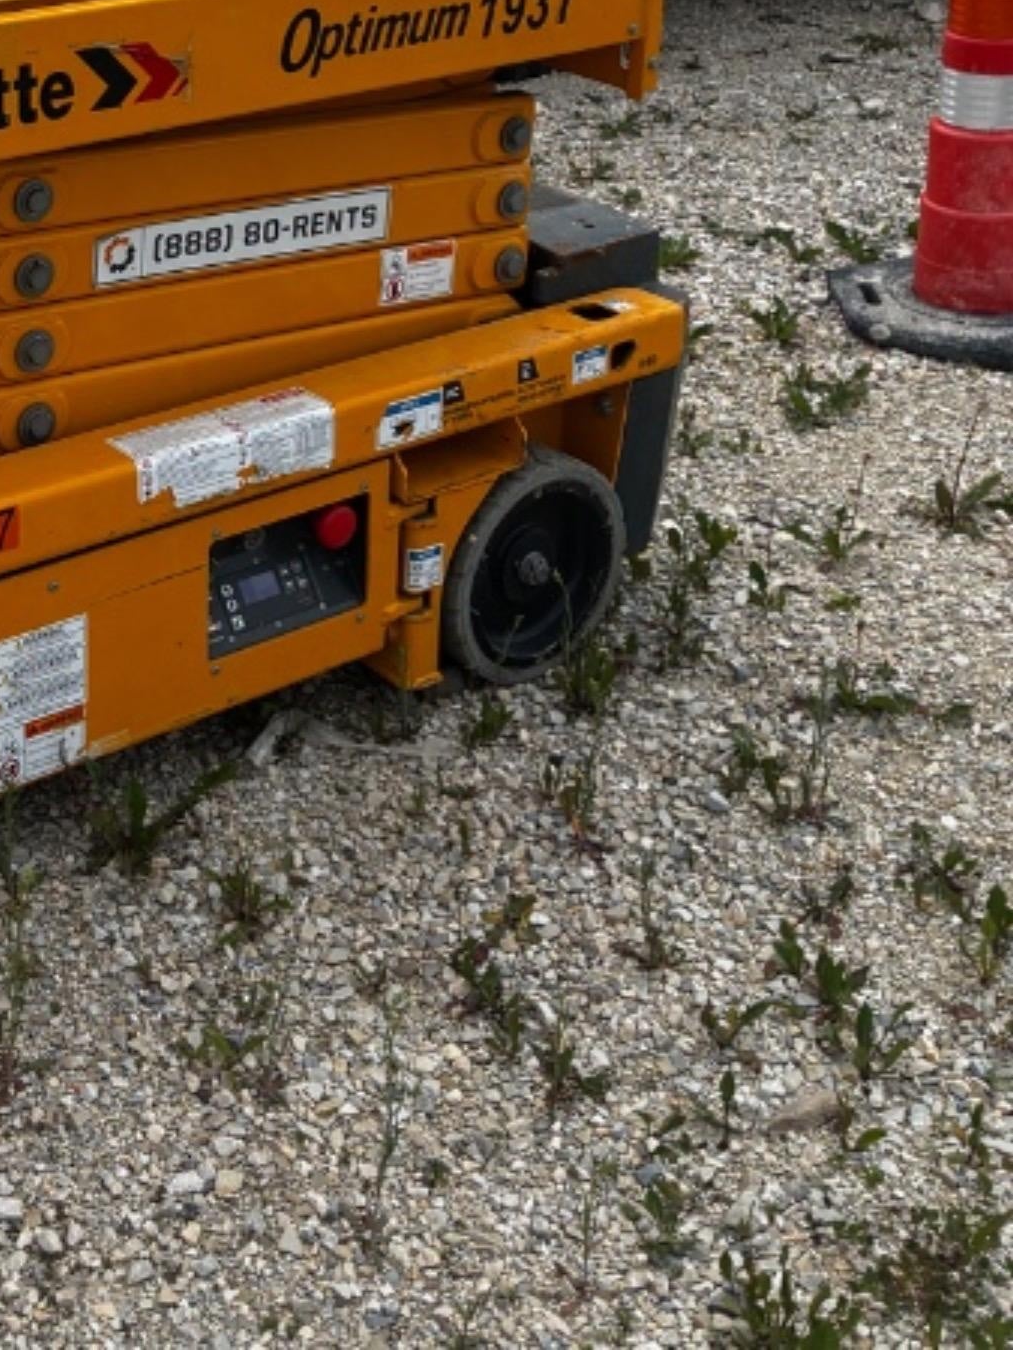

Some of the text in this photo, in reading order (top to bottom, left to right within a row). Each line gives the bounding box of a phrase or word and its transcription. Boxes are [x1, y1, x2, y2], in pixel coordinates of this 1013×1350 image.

[280, 2, 470, 78] Optimum
[153, 203, 378, 264] (888) 80-RENTS
